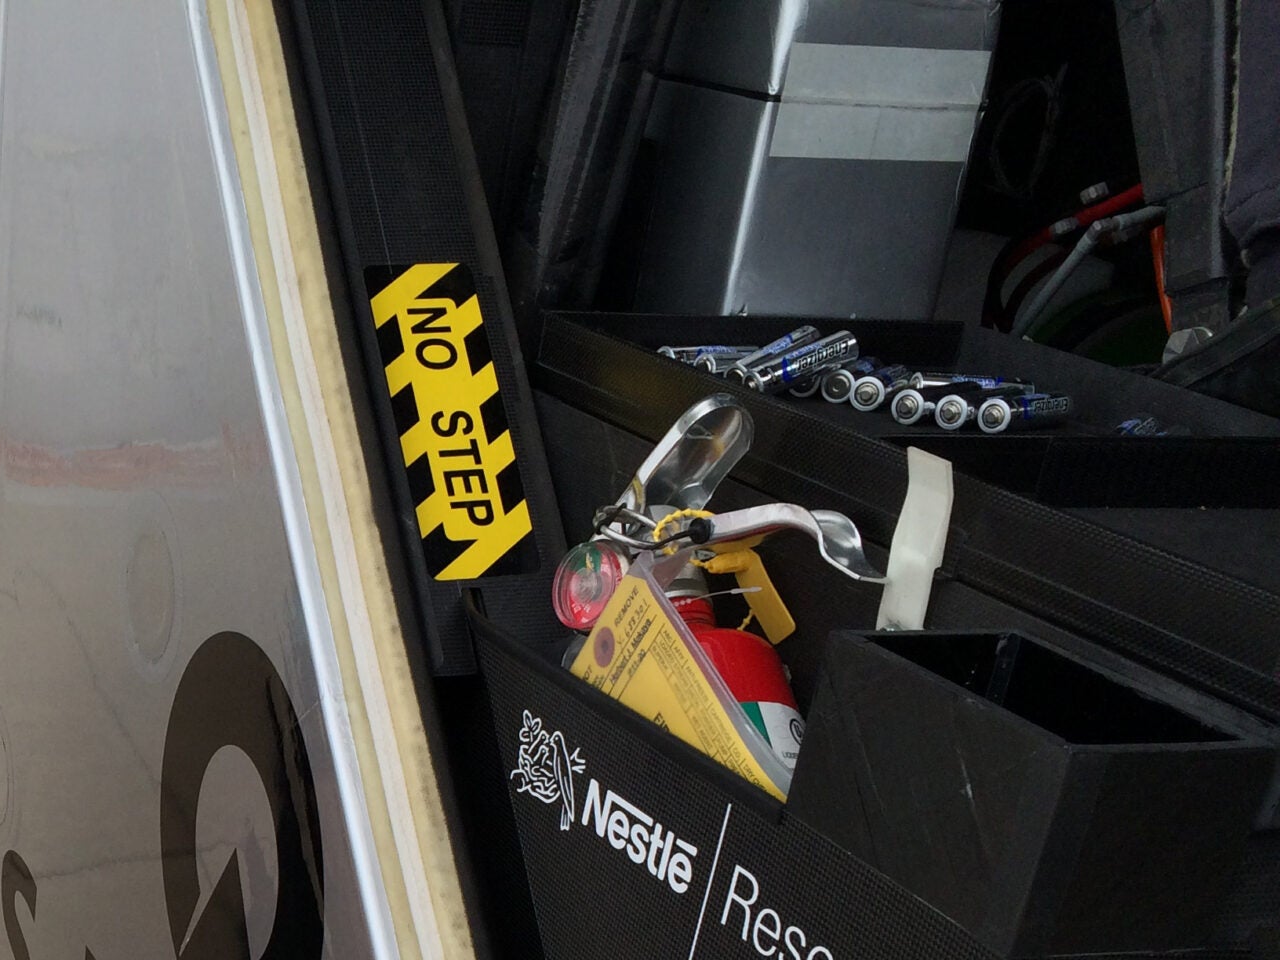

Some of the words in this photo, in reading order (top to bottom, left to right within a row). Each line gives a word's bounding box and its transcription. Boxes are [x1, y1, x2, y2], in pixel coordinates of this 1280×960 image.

[407, 306, 458, 370] NO
[796, 337, 851, 371] Energizer
[431, 410, 495, 527] STEP
[612, 585, 640, 627] REMOVE
[582, 778, 698, 894] Nestlé
